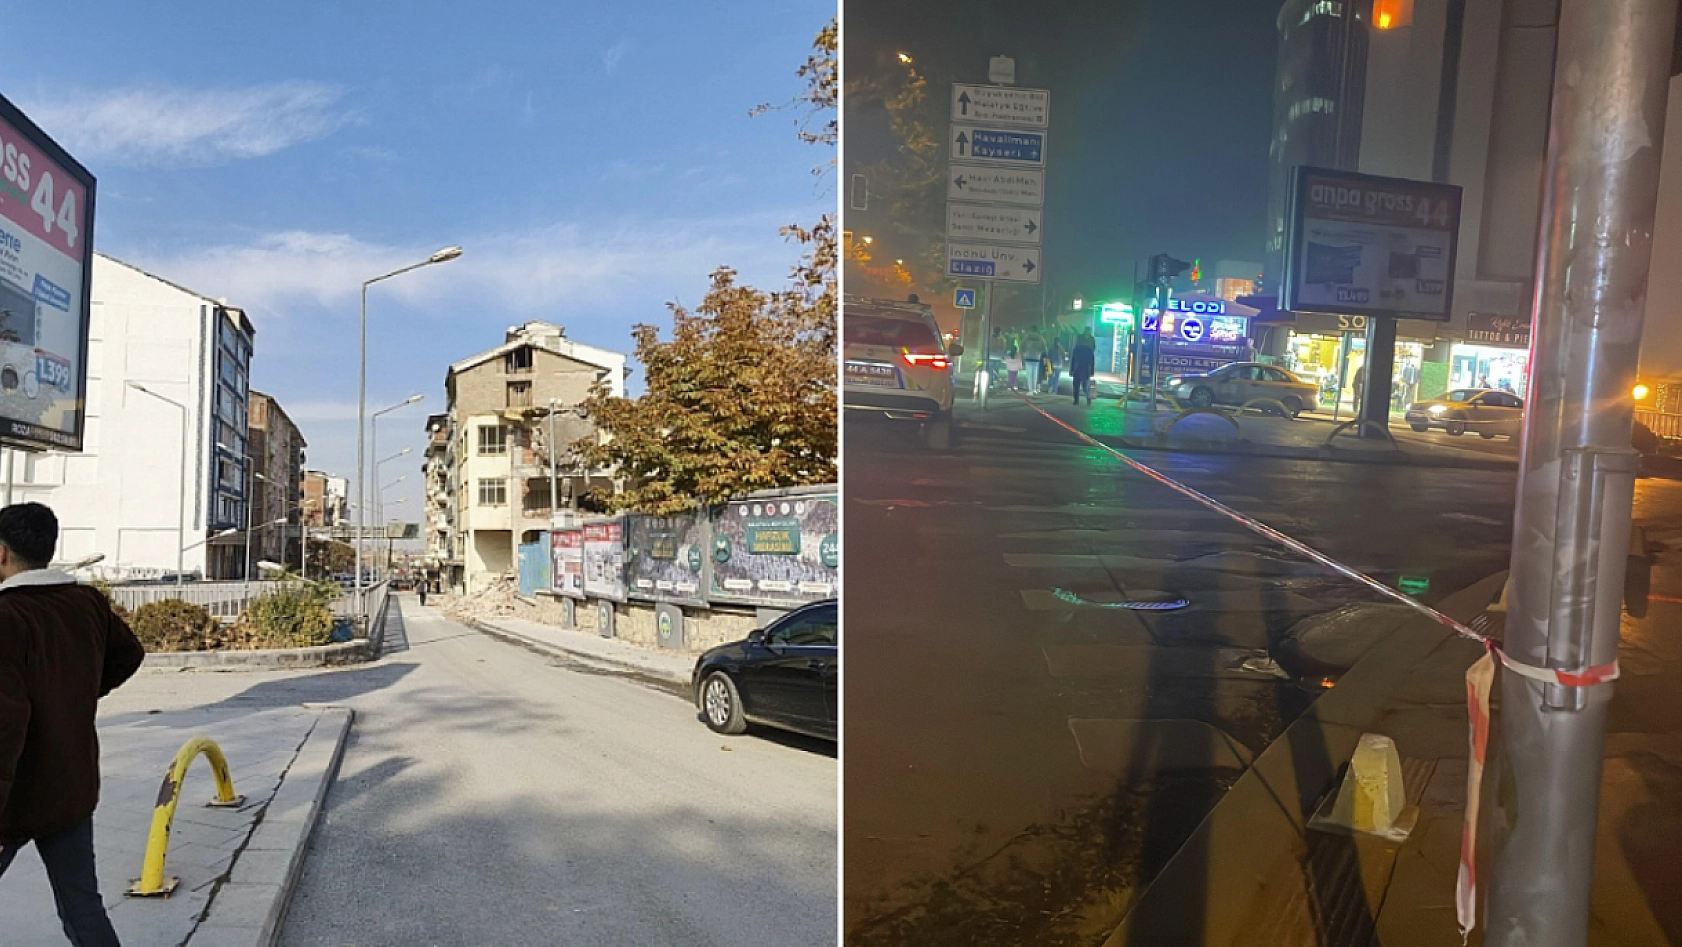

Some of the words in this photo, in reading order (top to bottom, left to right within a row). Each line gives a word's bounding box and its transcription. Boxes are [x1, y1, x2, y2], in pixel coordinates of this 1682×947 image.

[974, 100, 1011, 110] Malatya
[974, 132, 1040, 146] Havalimanı
[974, 145, 1021, 157] Kayseri
[31, 170, 78, 248] 44
[1311, 184, 1361, 212] anpa
[1365, 190, 1413, 216] gross
[1415, 196, 1449, 226] 44
[977, 224, 1020, 237] Mezarlığı
[951, 261, 994, 275] Elazığ
[1468, 329, 1501, 342] TATTOO
[38, 357, 69, 387] 1.399
